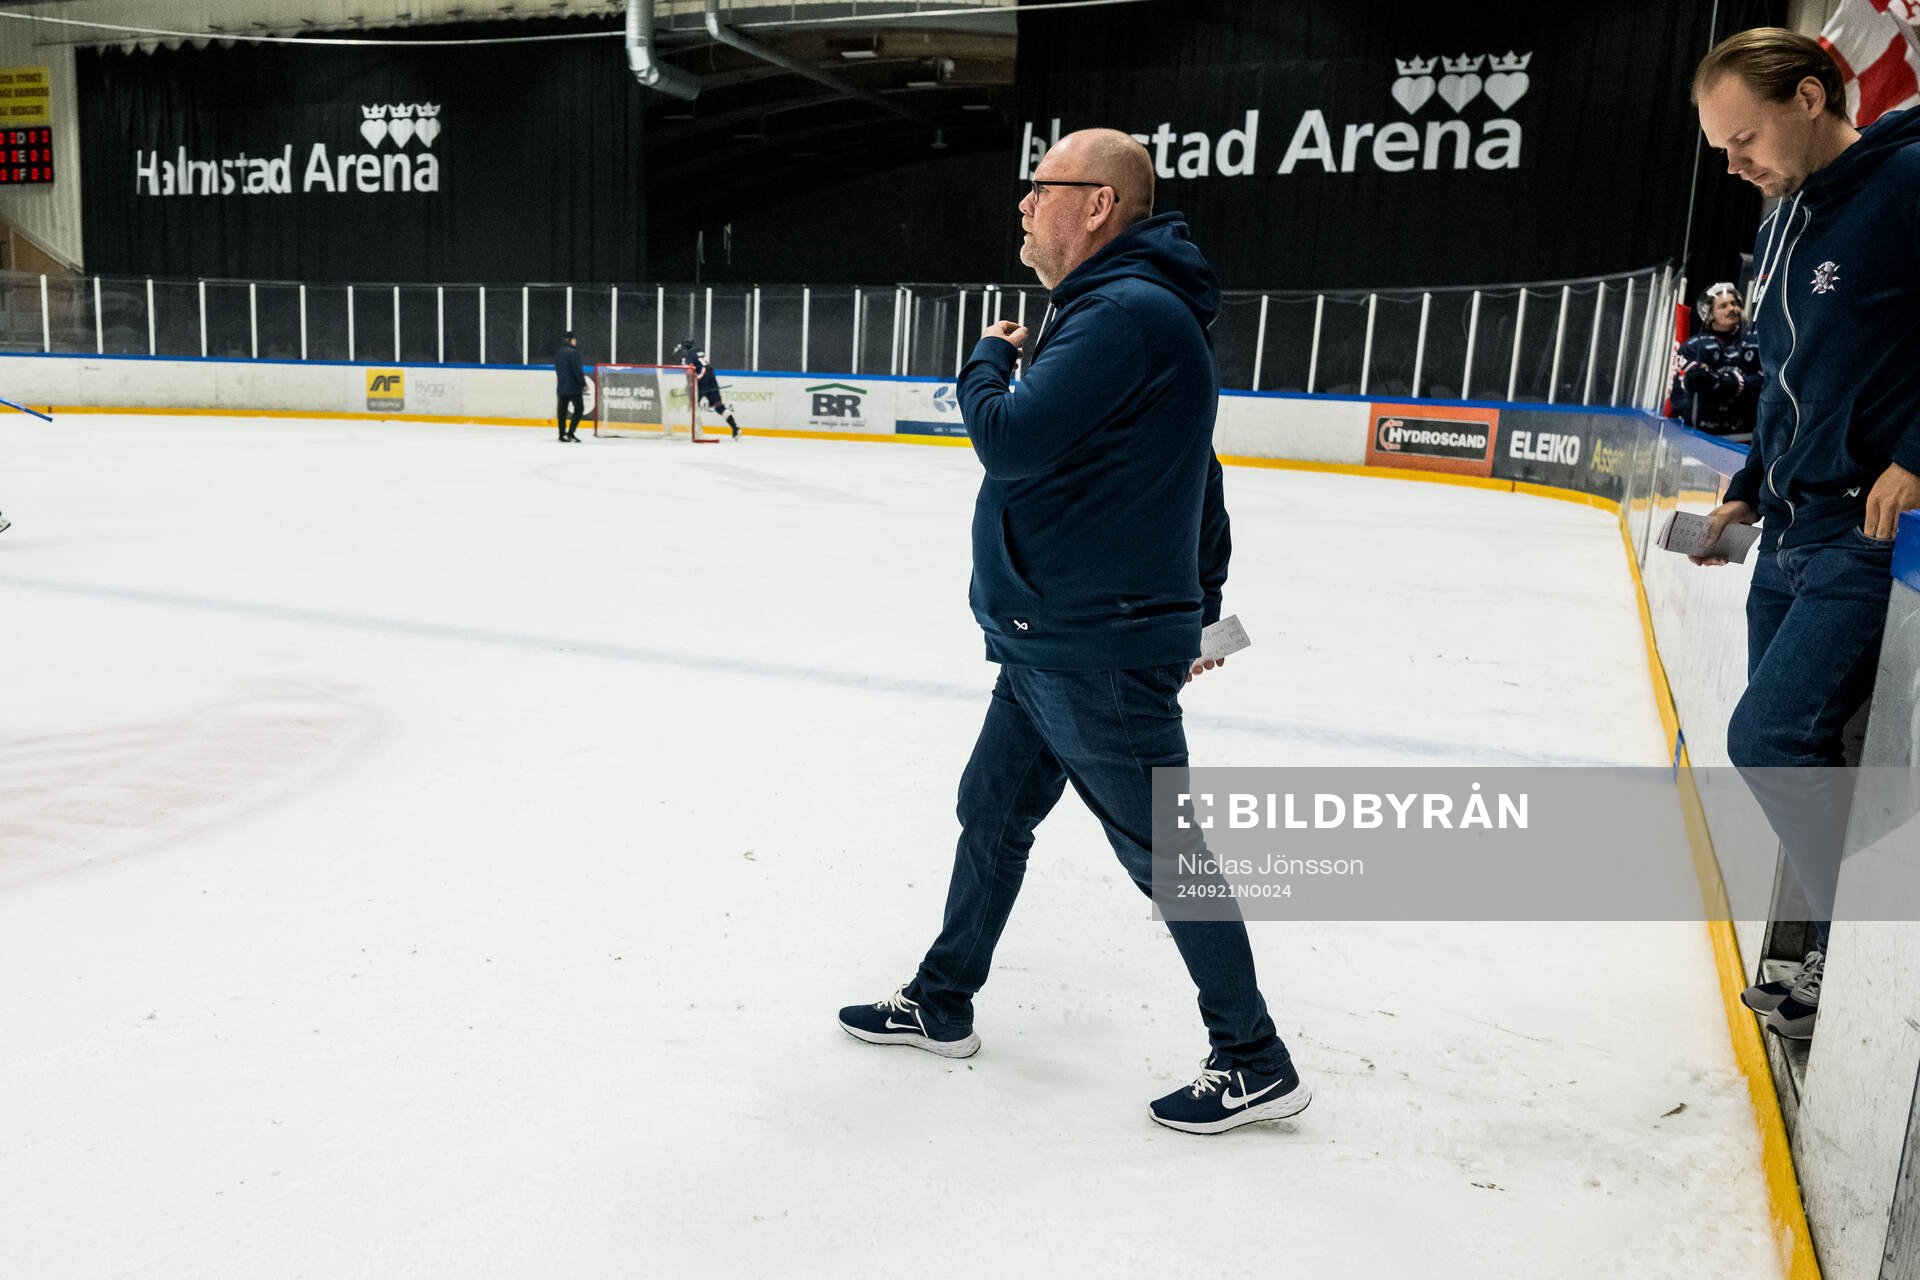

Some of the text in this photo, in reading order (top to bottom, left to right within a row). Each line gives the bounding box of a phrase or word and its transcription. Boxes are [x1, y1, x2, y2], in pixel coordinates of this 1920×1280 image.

[1277, 108, 1524, 176] Arena
[136, 143, 440, 196] Halmstad Arena
[633, 385, 655, 398] FÖR
[1388, 427, 1487, 449] HYDROSCAND
[1509, 430, 1581, 466] ELEIKO
